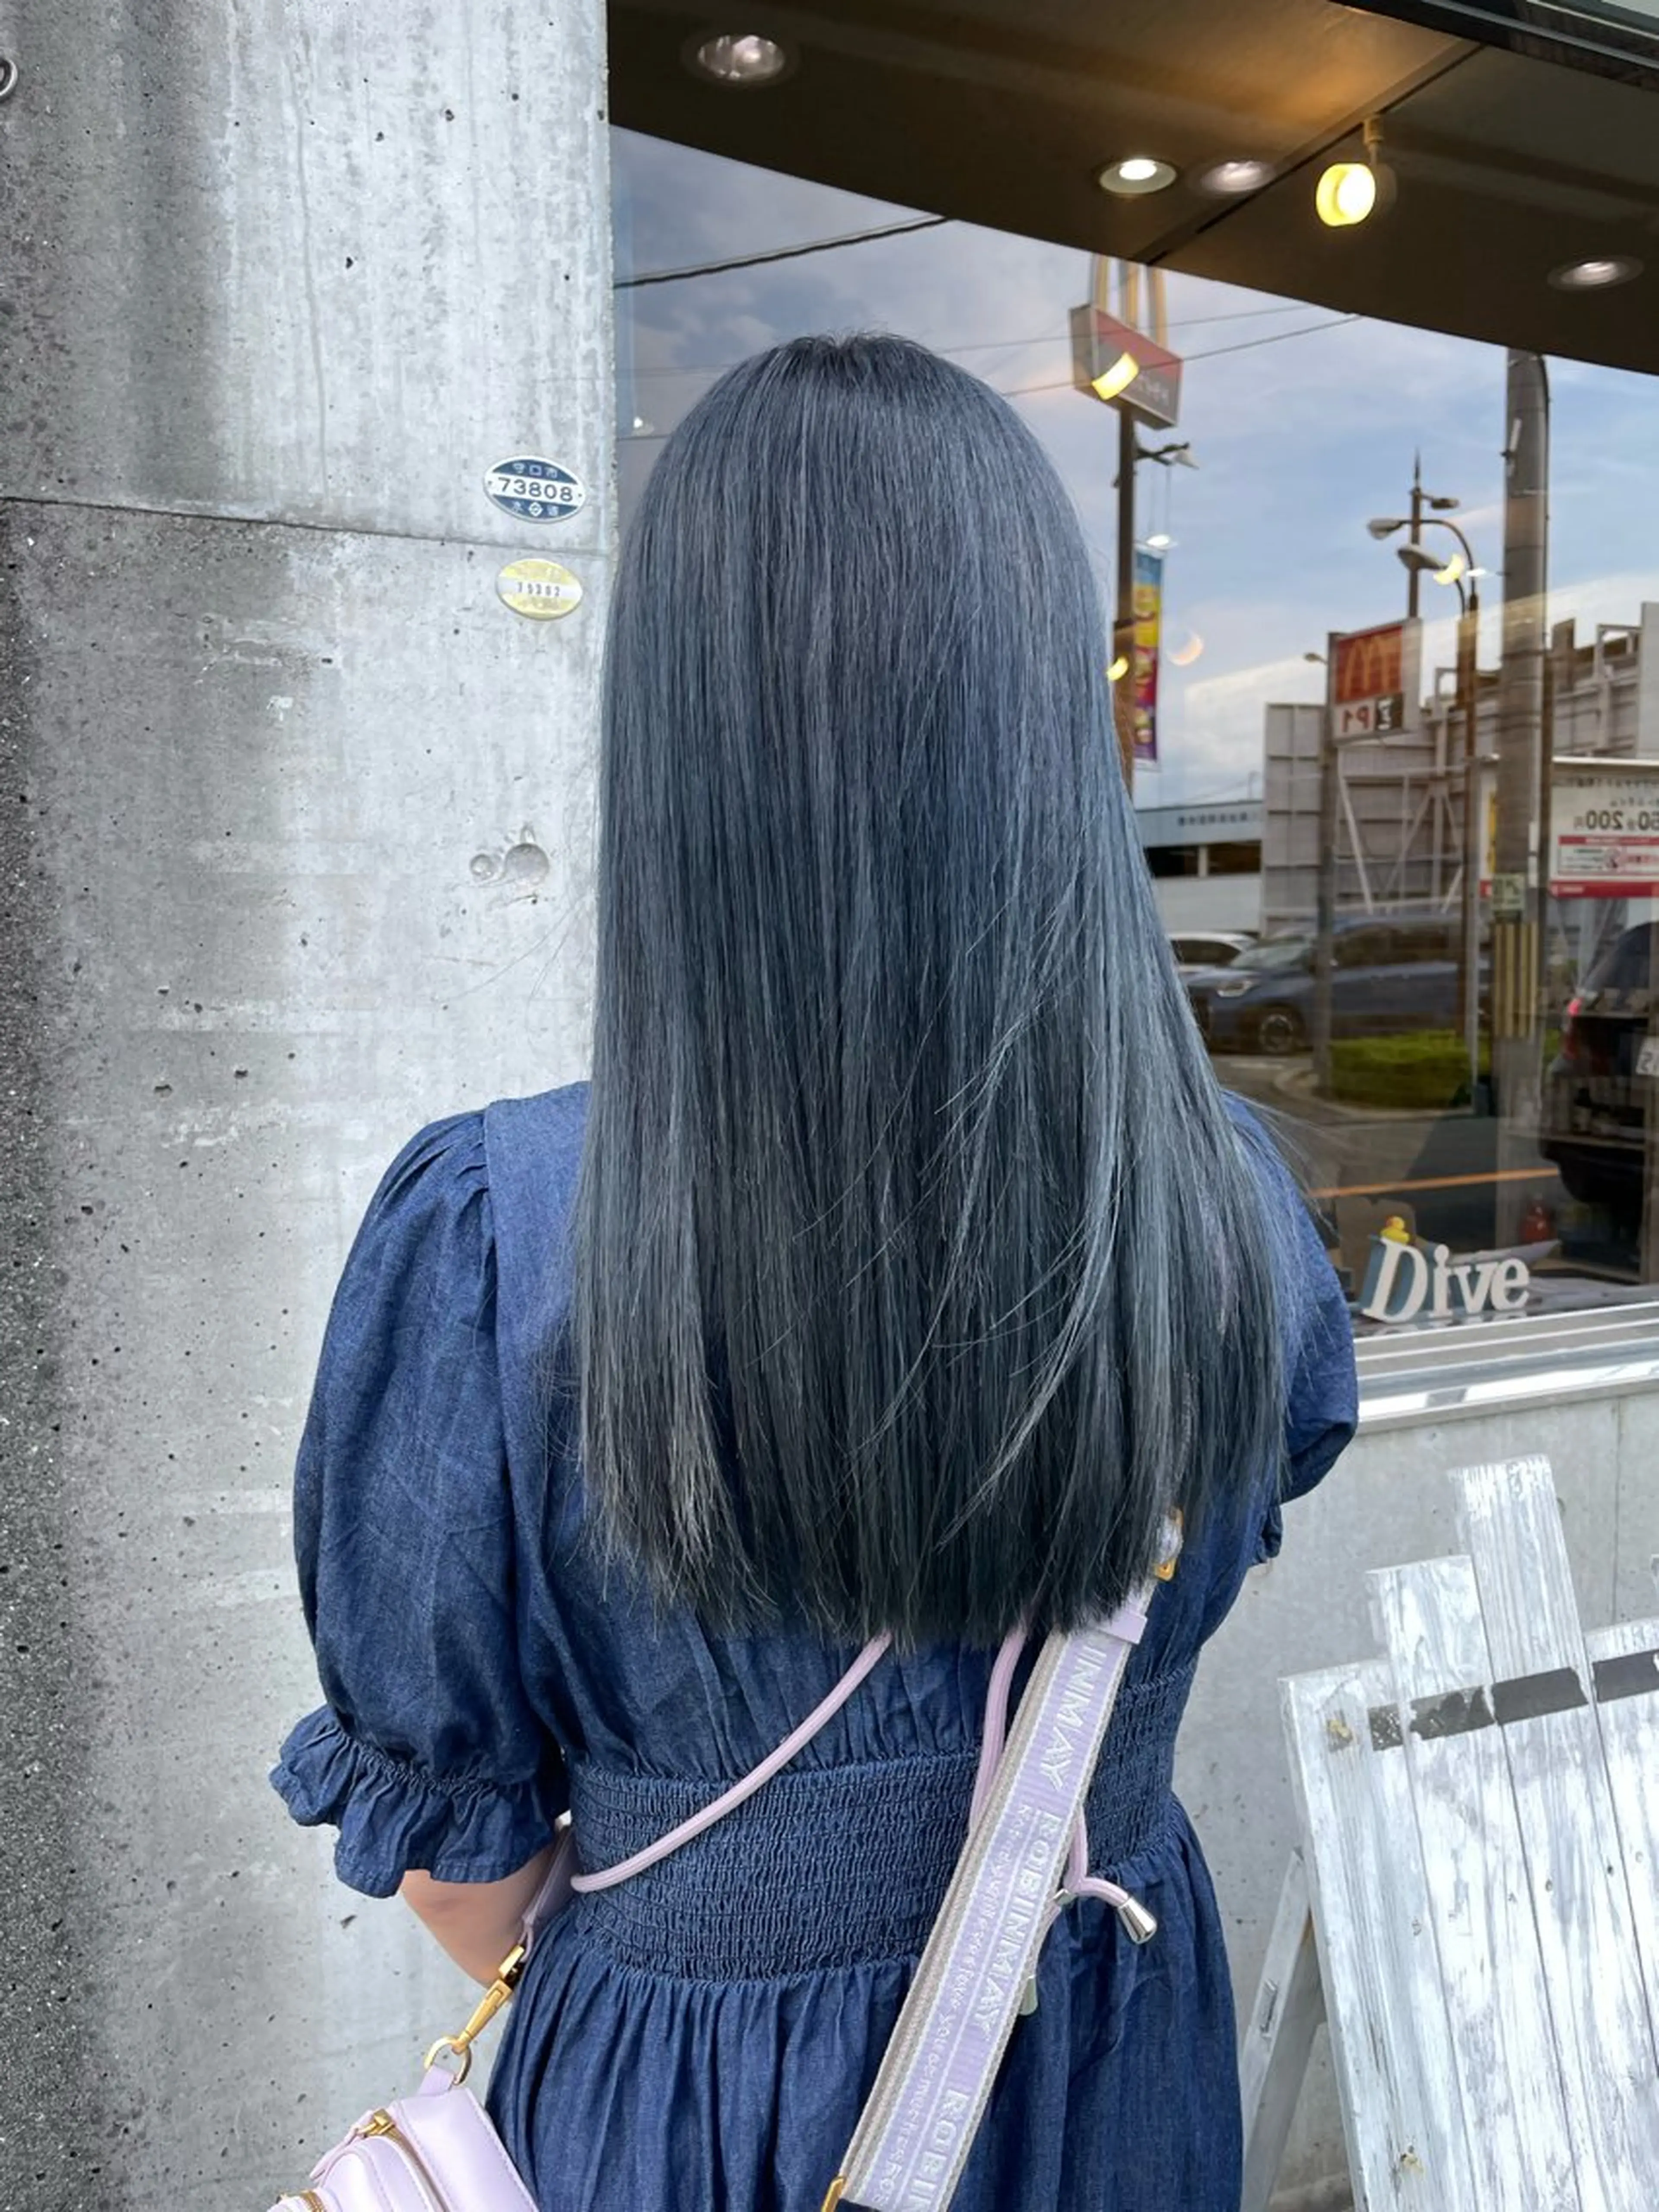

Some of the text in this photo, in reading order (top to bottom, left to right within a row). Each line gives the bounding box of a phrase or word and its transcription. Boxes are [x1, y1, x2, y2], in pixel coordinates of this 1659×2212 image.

[498, 477, 573, 502] 73808
[1362, 1238, 1530, 1324] Dive
[973, 1811, 1064, 2036] ROBINMAY
